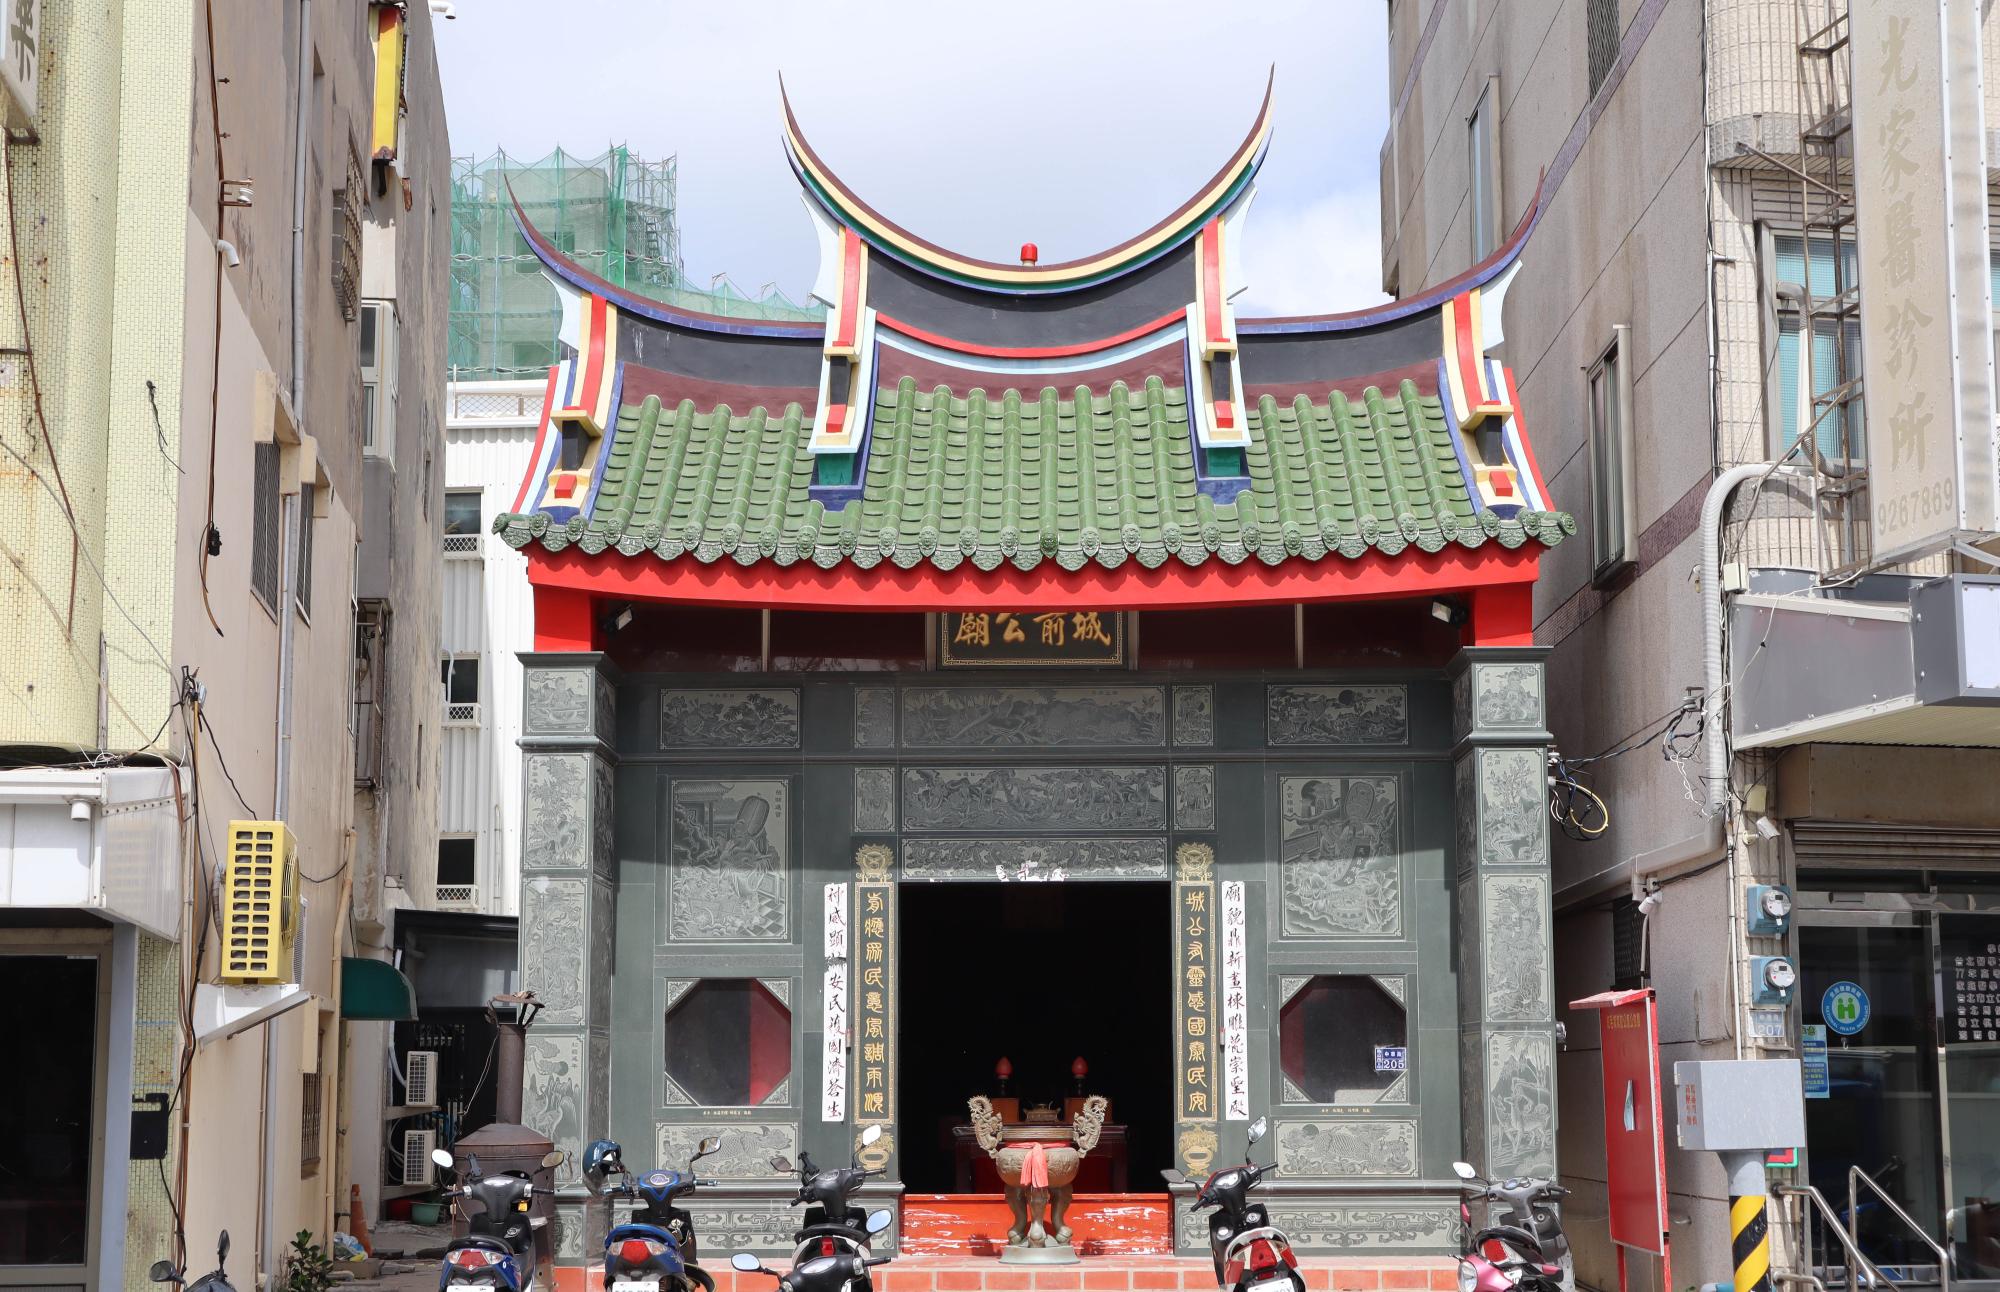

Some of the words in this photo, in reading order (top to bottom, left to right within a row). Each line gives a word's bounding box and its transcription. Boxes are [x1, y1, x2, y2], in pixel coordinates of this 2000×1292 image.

[1872, 0, 1933, 473] 光家醫診所
[953, 611, 1113, 648] 城前公廟
[1757, 1024, 1782, 1037] 207
[1383, 1059, 1405, 1069] 205
